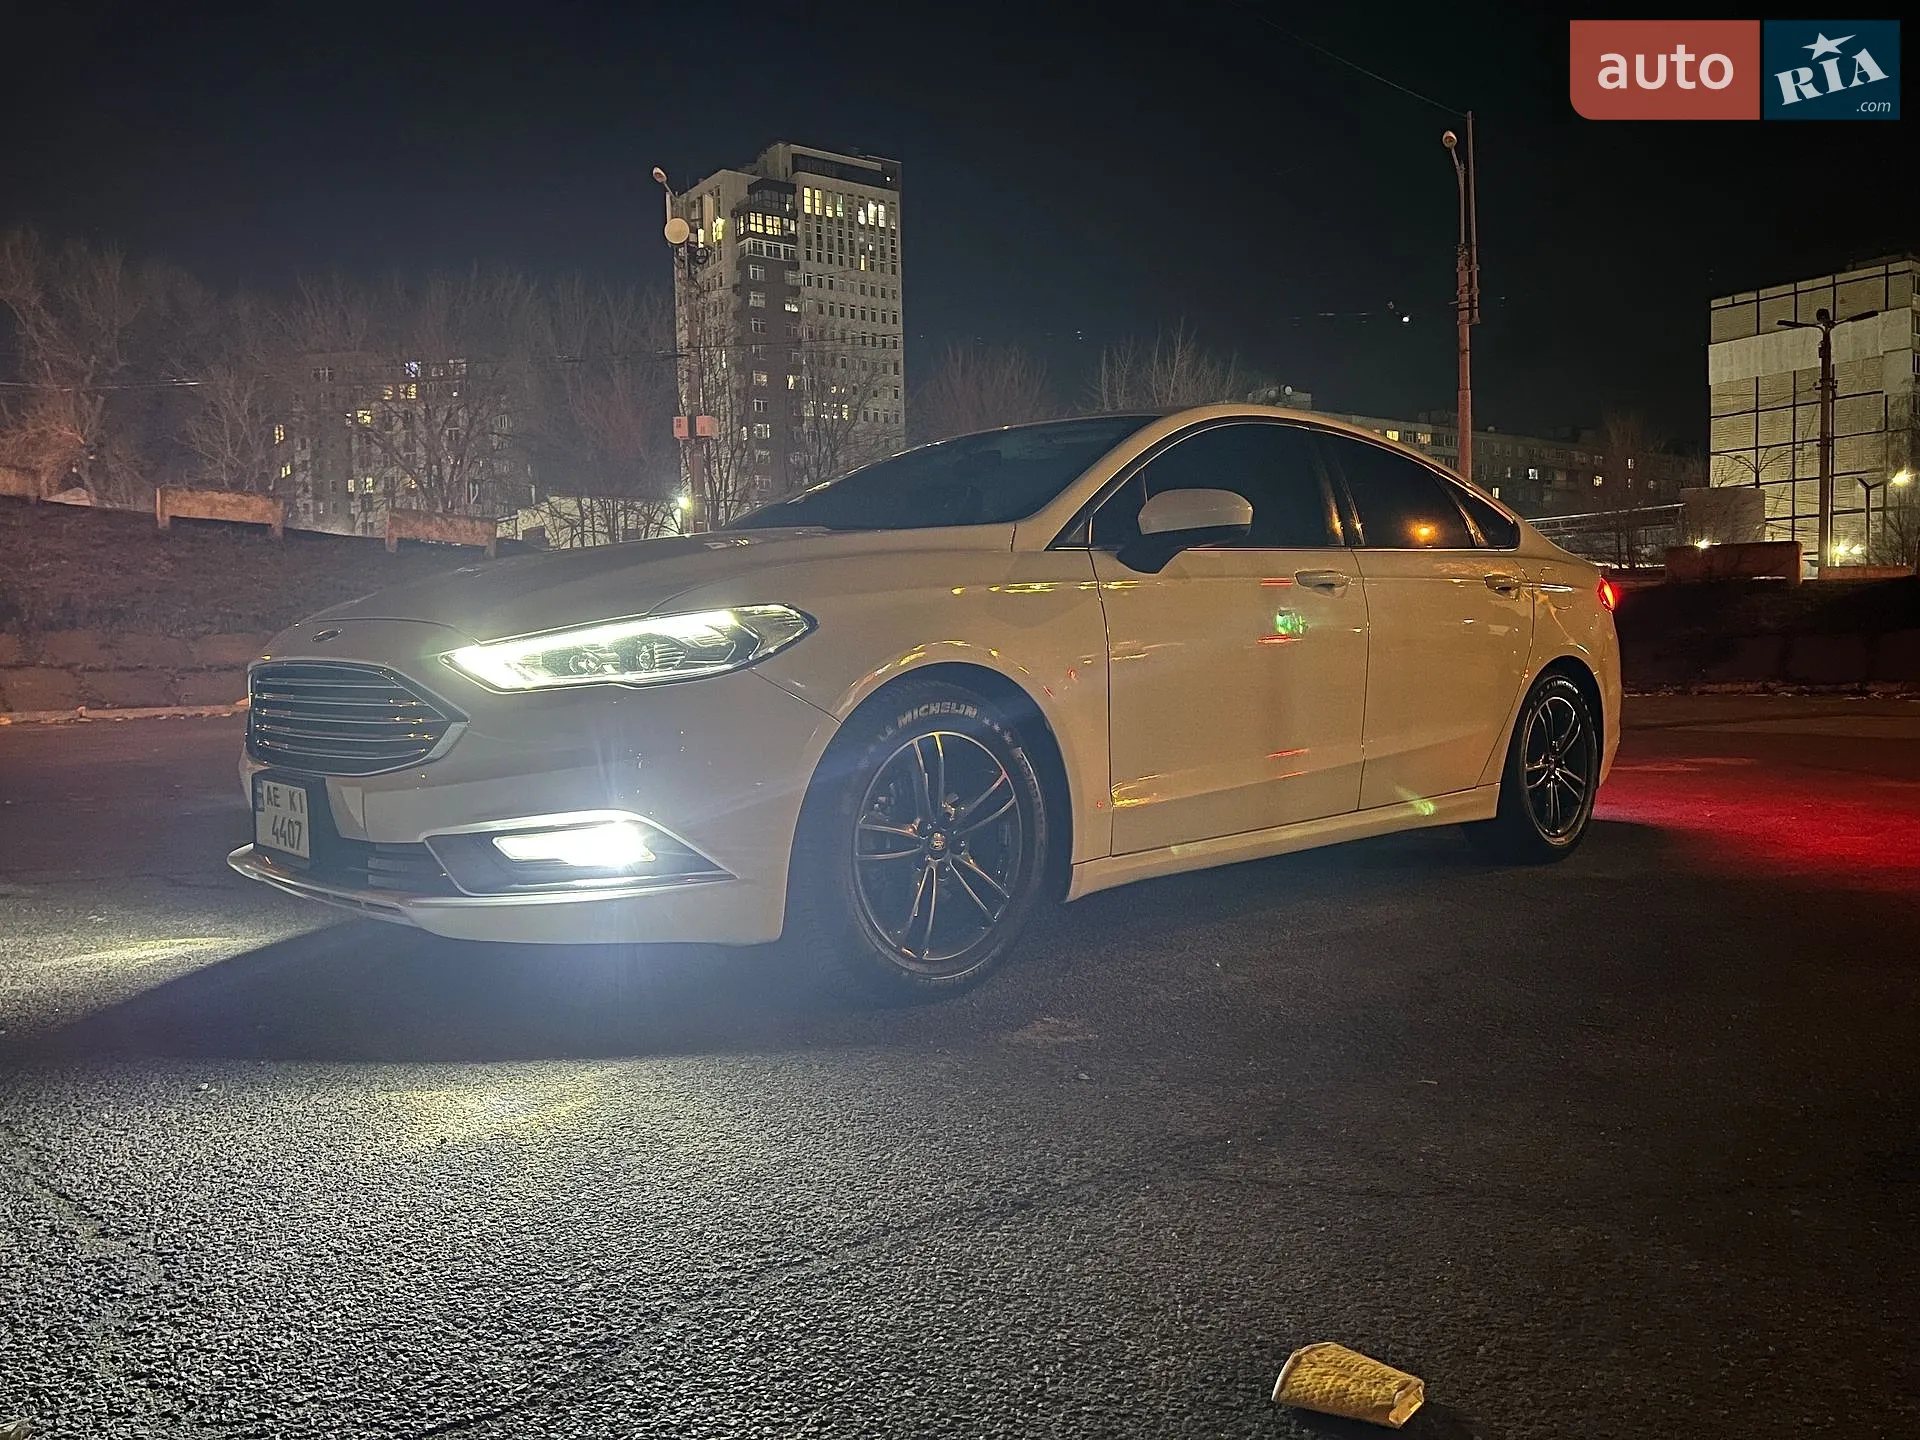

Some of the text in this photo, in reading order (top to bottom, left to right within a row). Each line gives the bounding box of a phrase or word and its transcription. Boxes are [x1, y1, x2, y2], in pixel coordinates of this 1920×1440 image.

[897, 701, 978, 728] MICHELIN
[266, 785, 281, 808] AE
[271, 815, 302, 850] 4407
